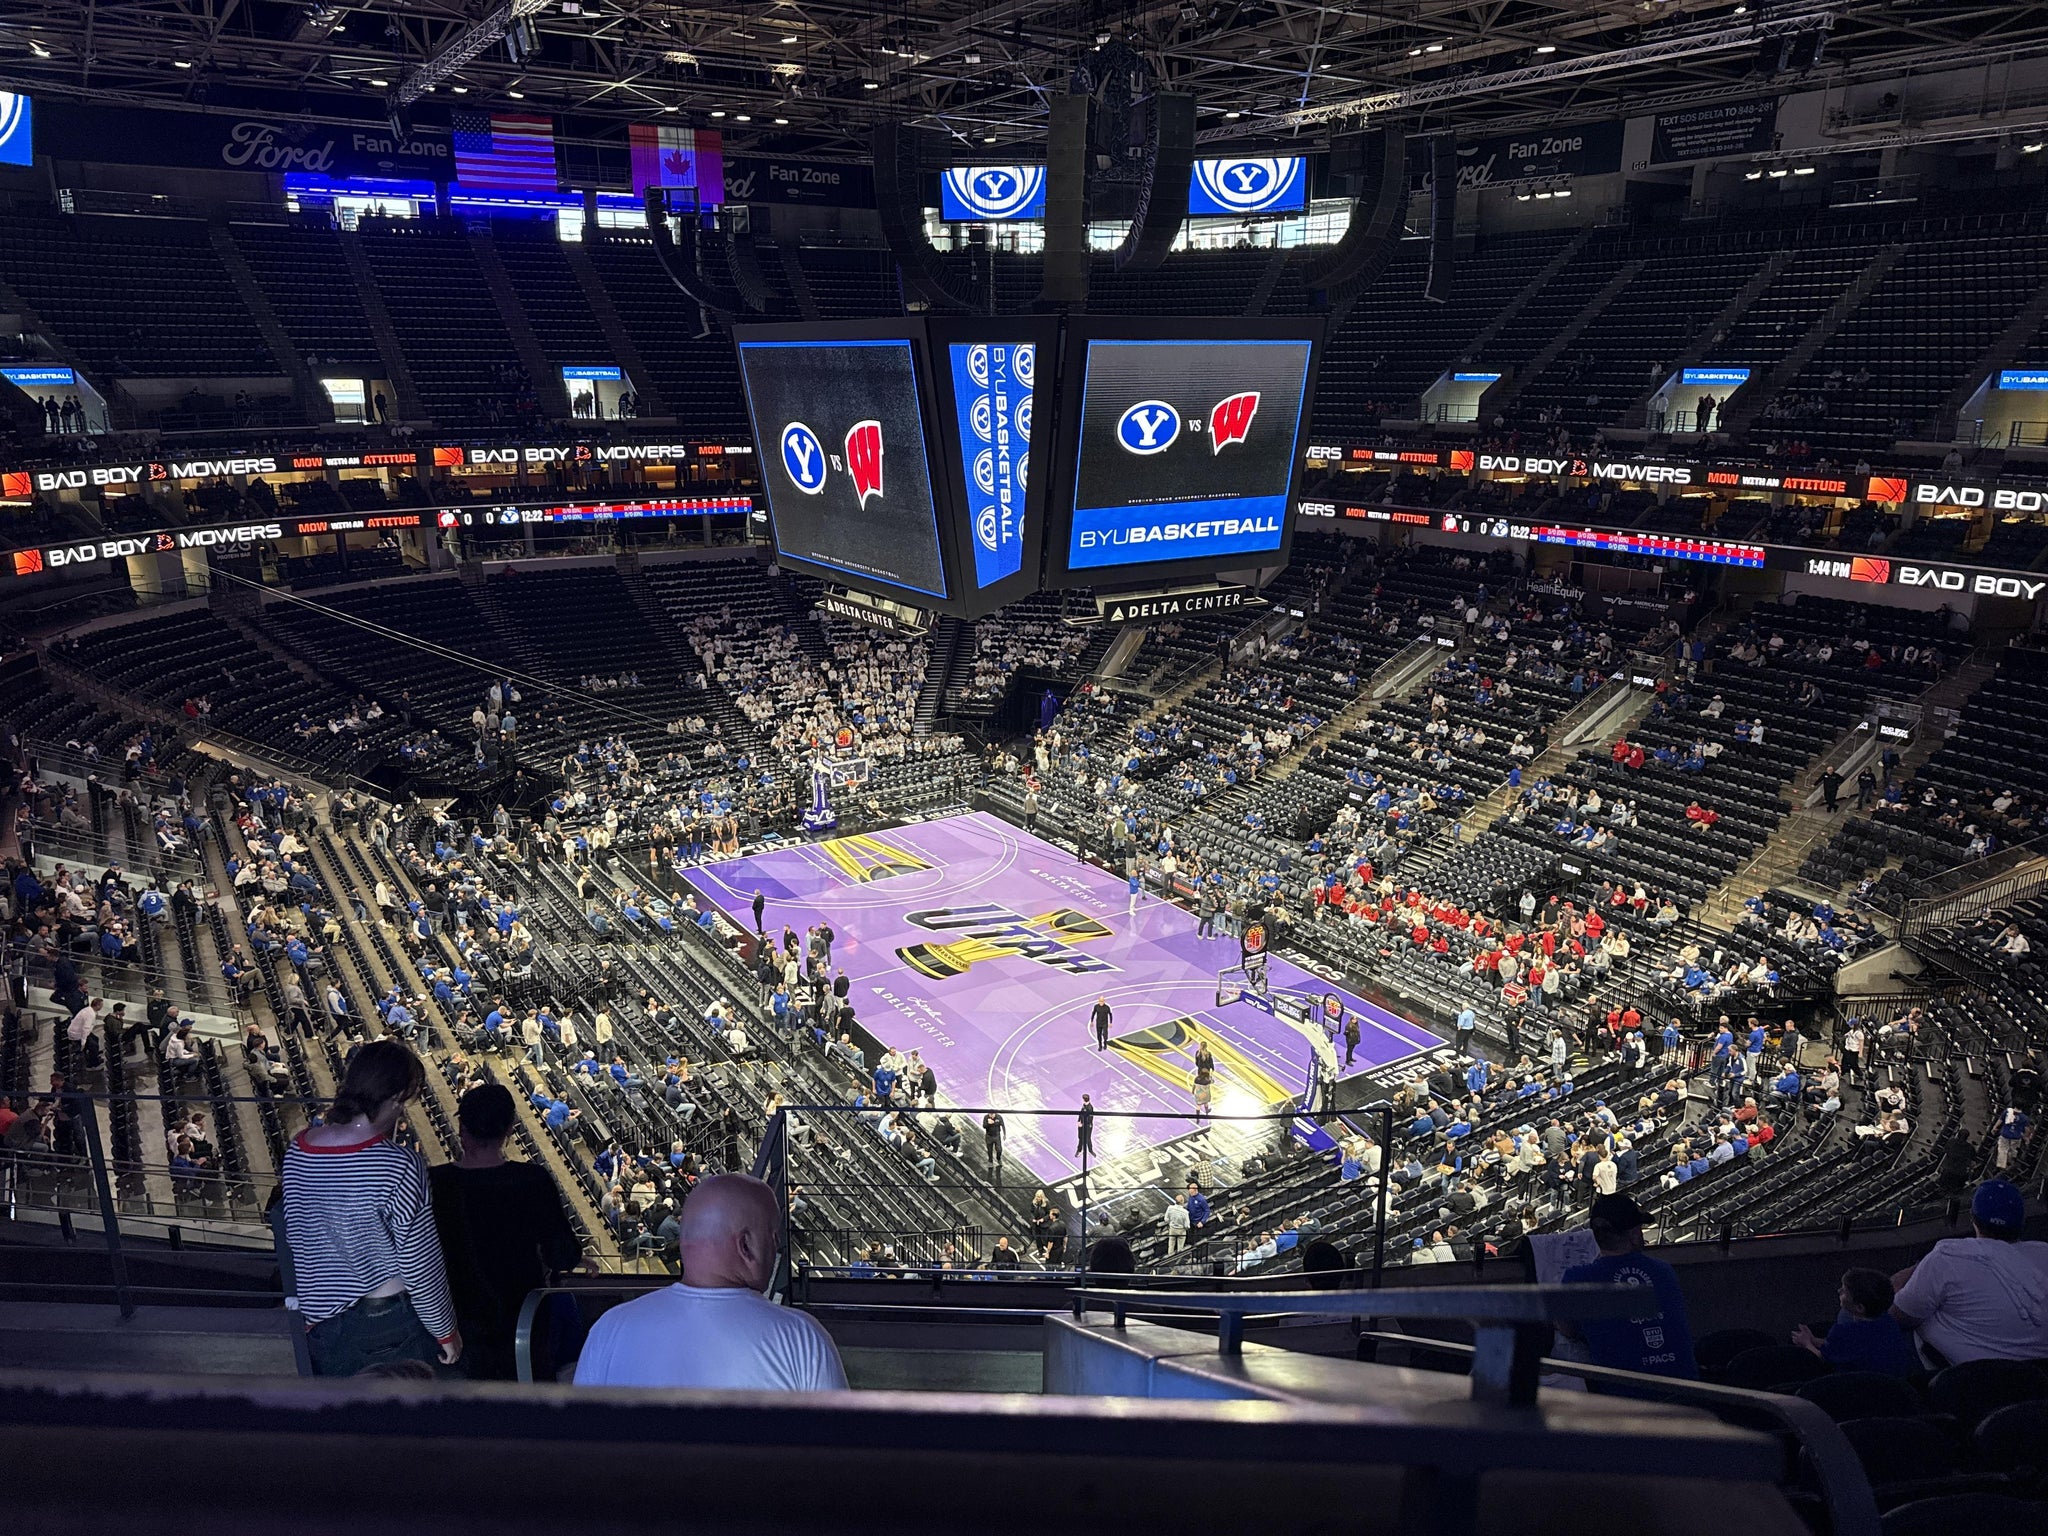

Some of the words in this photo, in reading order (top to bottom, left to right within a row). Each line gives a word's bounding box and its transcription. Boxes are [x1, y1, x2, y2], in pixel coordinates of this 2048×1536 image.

[1659, 115, 1679, 126] TEXT
[1680, 113, 1697, 124] SOS
[1698, 108, 1724, 121] DELTA
[1725, 107, 1737, 117] TO
[1738, 102, 1775, 115] 848-281
[222, 121, 337, 172] Ford
[352, 133, 393, 153] Fan
[398, 138, 448, 157] Zone
[1508, 142, 1539, 159] Fan
[1542, 135, 1583, 156] Zone
[769, 165, 799, 182] Fan
[802, 167, 841, 185] Zone
[564, 369, 620, 377] BYUBASKETBALL
[1188, 419, 1201, 432] VS
[1208, 391, 1261, 457] W
[471, 448, 518, 463] BAD
[525, 447, 570, 462] BOY
[597, 445, 686, 460] MOWERS
[698, 446, 722, 455] MOW
[724, 446, 742, 454] WITH
[993, 347, 1014, 545] BYUBASKETBALL
[1352, 449, 1373, 460] MOW
[1400, 451, 1438, 464] ATTITUDE
[293, 457, 322, 468] MOW
[325, 458, 347, 466] WITH
[347, 456, 359, 465] AN
[363, 453, 416, 465] ATTITUDE
[830, 454, 842, 472] VS
[845, 420, 884, 511] W
[1479, 456, 1519, 471] BAD
[1525, 458, 1568, 475] BOY
[1593, 462, 1692, 485] MOWERS
[38, 470, 87, 491] BAD
[93, 465, 143, 485] BOY
[172, 457, 277, 478] MOWERS
[1707, 472, 1738, 486] MOW
[1742, 476, 1766, 485] WITH
[1765, 478, 1779, 488] AN
[1782, 477, 1847, 493] ATTITUDE
[1916, 483, 1984, 507] BAD
[1994, 489, 2048, 511] BOY
[298, 522, 327, 533] MOW
[330, 522, 352, 530] WITH
[352, 520, 364, 529] AN
[367, 516, 420, 528] ATTITUDE
[464, 513, 472, 526] 0
[485, 512, 494, 525] 0
[521, 509, 544, 522] 12:22
[1346, 508, 1366, 518] MOW
[1392, 511, 1430, 524] ATTITUDE
[1079, 516, 1280, 548] BYUBASKETBALL
[1462, 520, 1470, 532] 0
[1480, 522, 1488, 534] 0
[1510, 525, 1530, 539] 12:22
[49, 545, 97, 568] BAD
[102, 537, 151, 560] BOY
[179, 523, 282, 549] MOWERS
[217, 553, 239, 561] PROTEIN
[1807, 558, 1831, 576] 1:44
[1831, 561, 1851, 578] PM
[1526, 581, 1584, 601] HealthEquity
[1899, 566, 1965, 591] BAD
[1974, 574, 2046, 600] BOY
[834, 600, 861, 620] DELTA
[862, 610, 894, 630] CENTER
[1128, 601, 1180, 618] DELTA
[1185, 594, 1241, 611] CENTER
[925, 806, 976, 820] HEALTH
[150, 895, 157, 905] 3
[1038, 872, 1070, 893] DELTA
[1069, 887, 1108, 909] CENTER
[902, 901, 1127, 977] UTAH
[1286, 952, 1347, 981] PACS
[881, 992, 917, 1018] DELTA
[913, 1016, 957, 1049] CENTER
[1374, 1061, 1440, 1089] HEALTH
[1304, 1079, 1314, 1107] AMERICA
[1646, 1329, 1660, 1337] BYU
[1649, 1353, 1676, 1365] PACS
